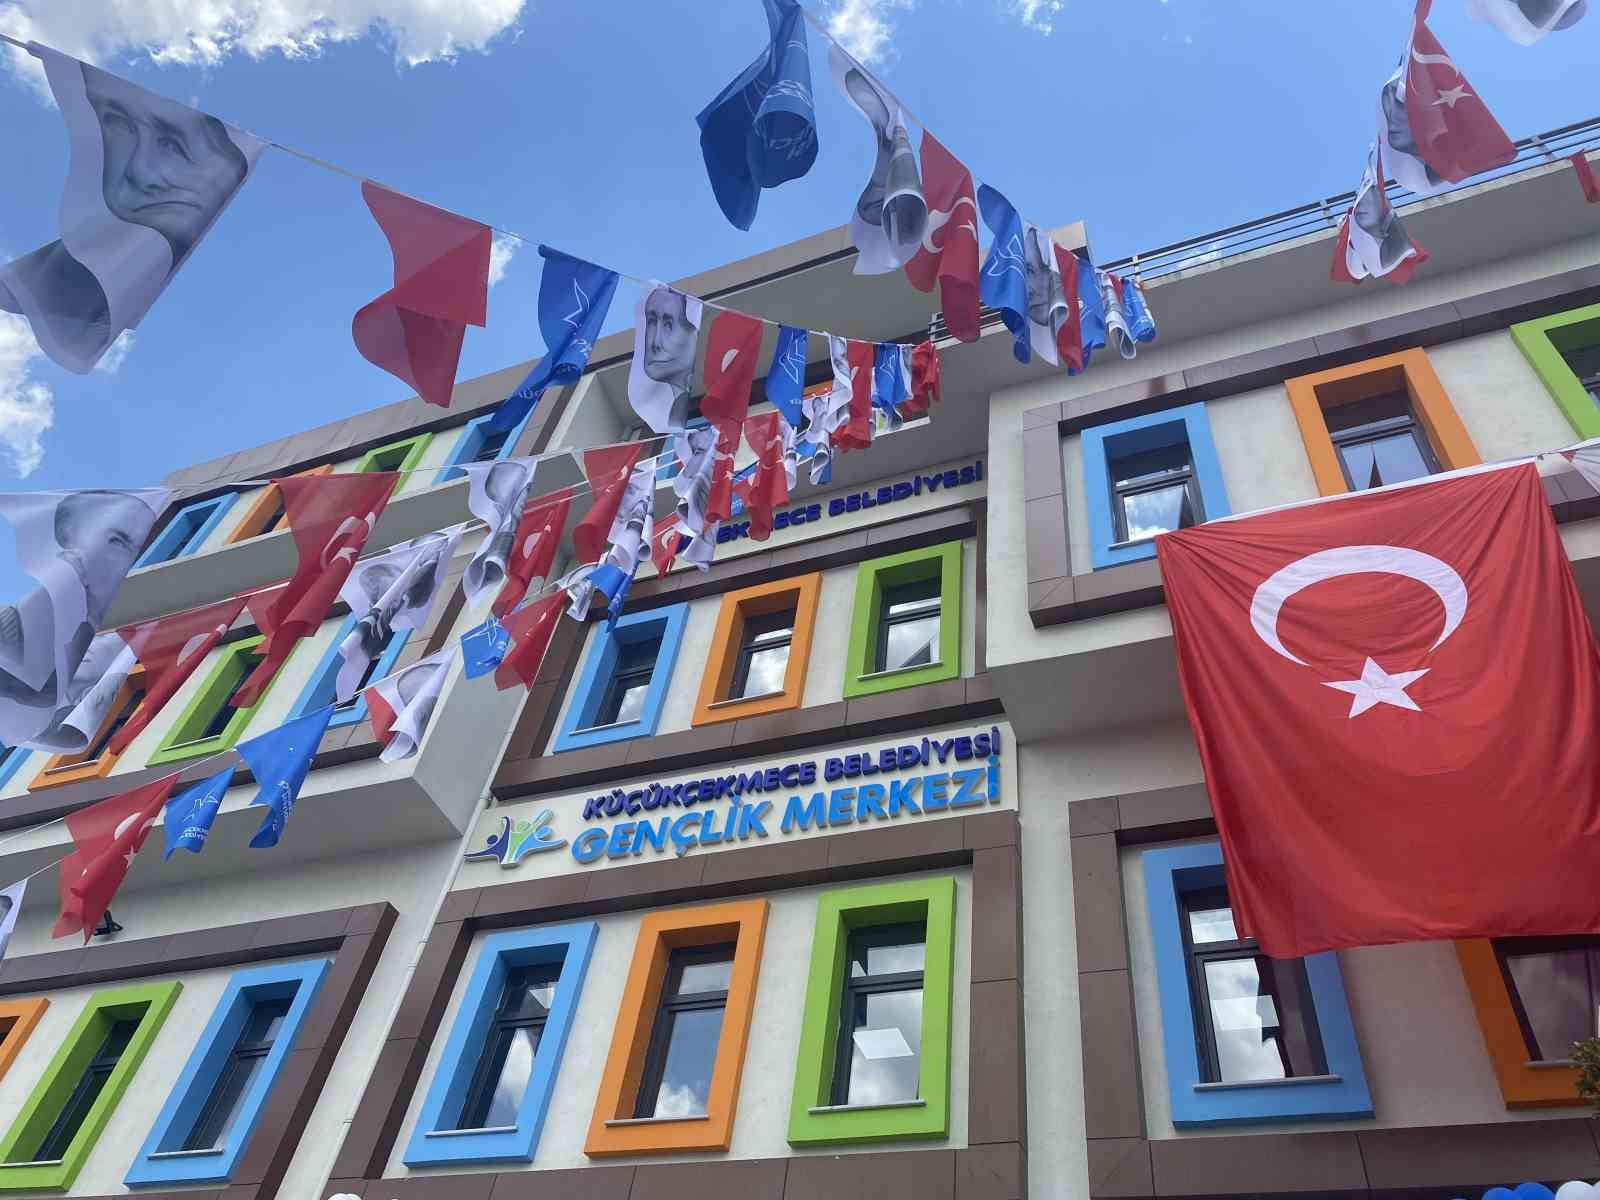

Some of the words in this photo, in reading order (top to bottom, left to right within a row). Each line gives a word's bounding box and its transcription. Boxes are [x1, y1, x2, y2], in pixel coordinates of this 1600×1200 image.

[571, 795, 774, 865] GENÇLİK
[780, 754, 1001, 834] MERKEZİ
[582, 760, 817, 821] KÜÇÜKÇEKMECE
[824, 725, 1000, 782] BELEDİYESİ
